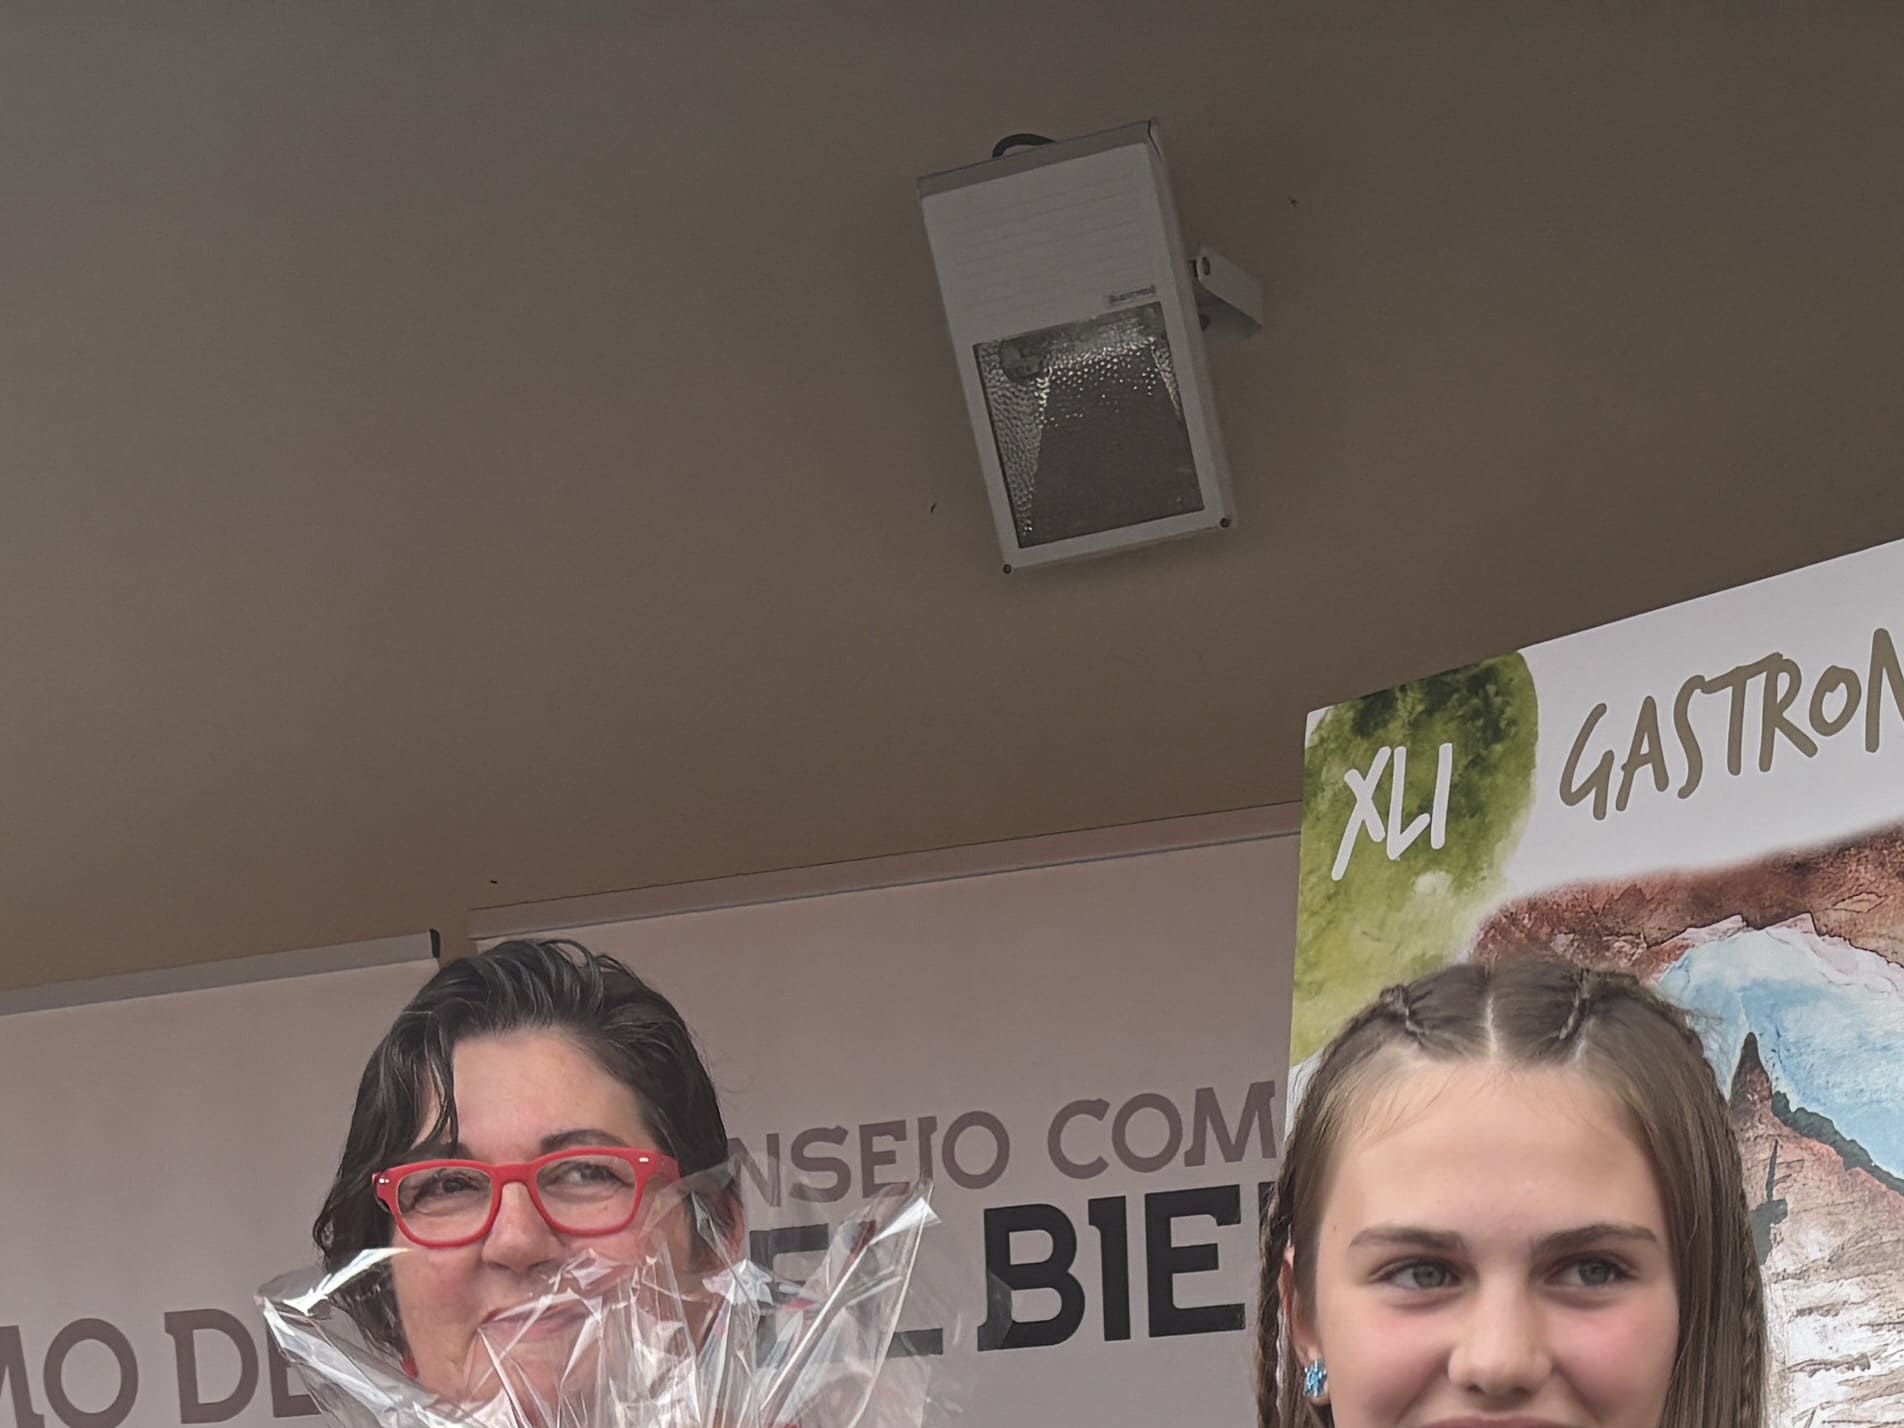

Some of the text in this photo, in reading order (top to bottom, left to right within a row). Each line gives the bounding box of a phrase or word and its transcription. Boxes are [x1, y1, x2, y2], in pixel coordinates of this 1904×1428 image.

[1331, 742, 1453, 881] XLI
[1047, 1080, 1277, 1179] COM
[977, 1181, 1276, 1353] BIE
